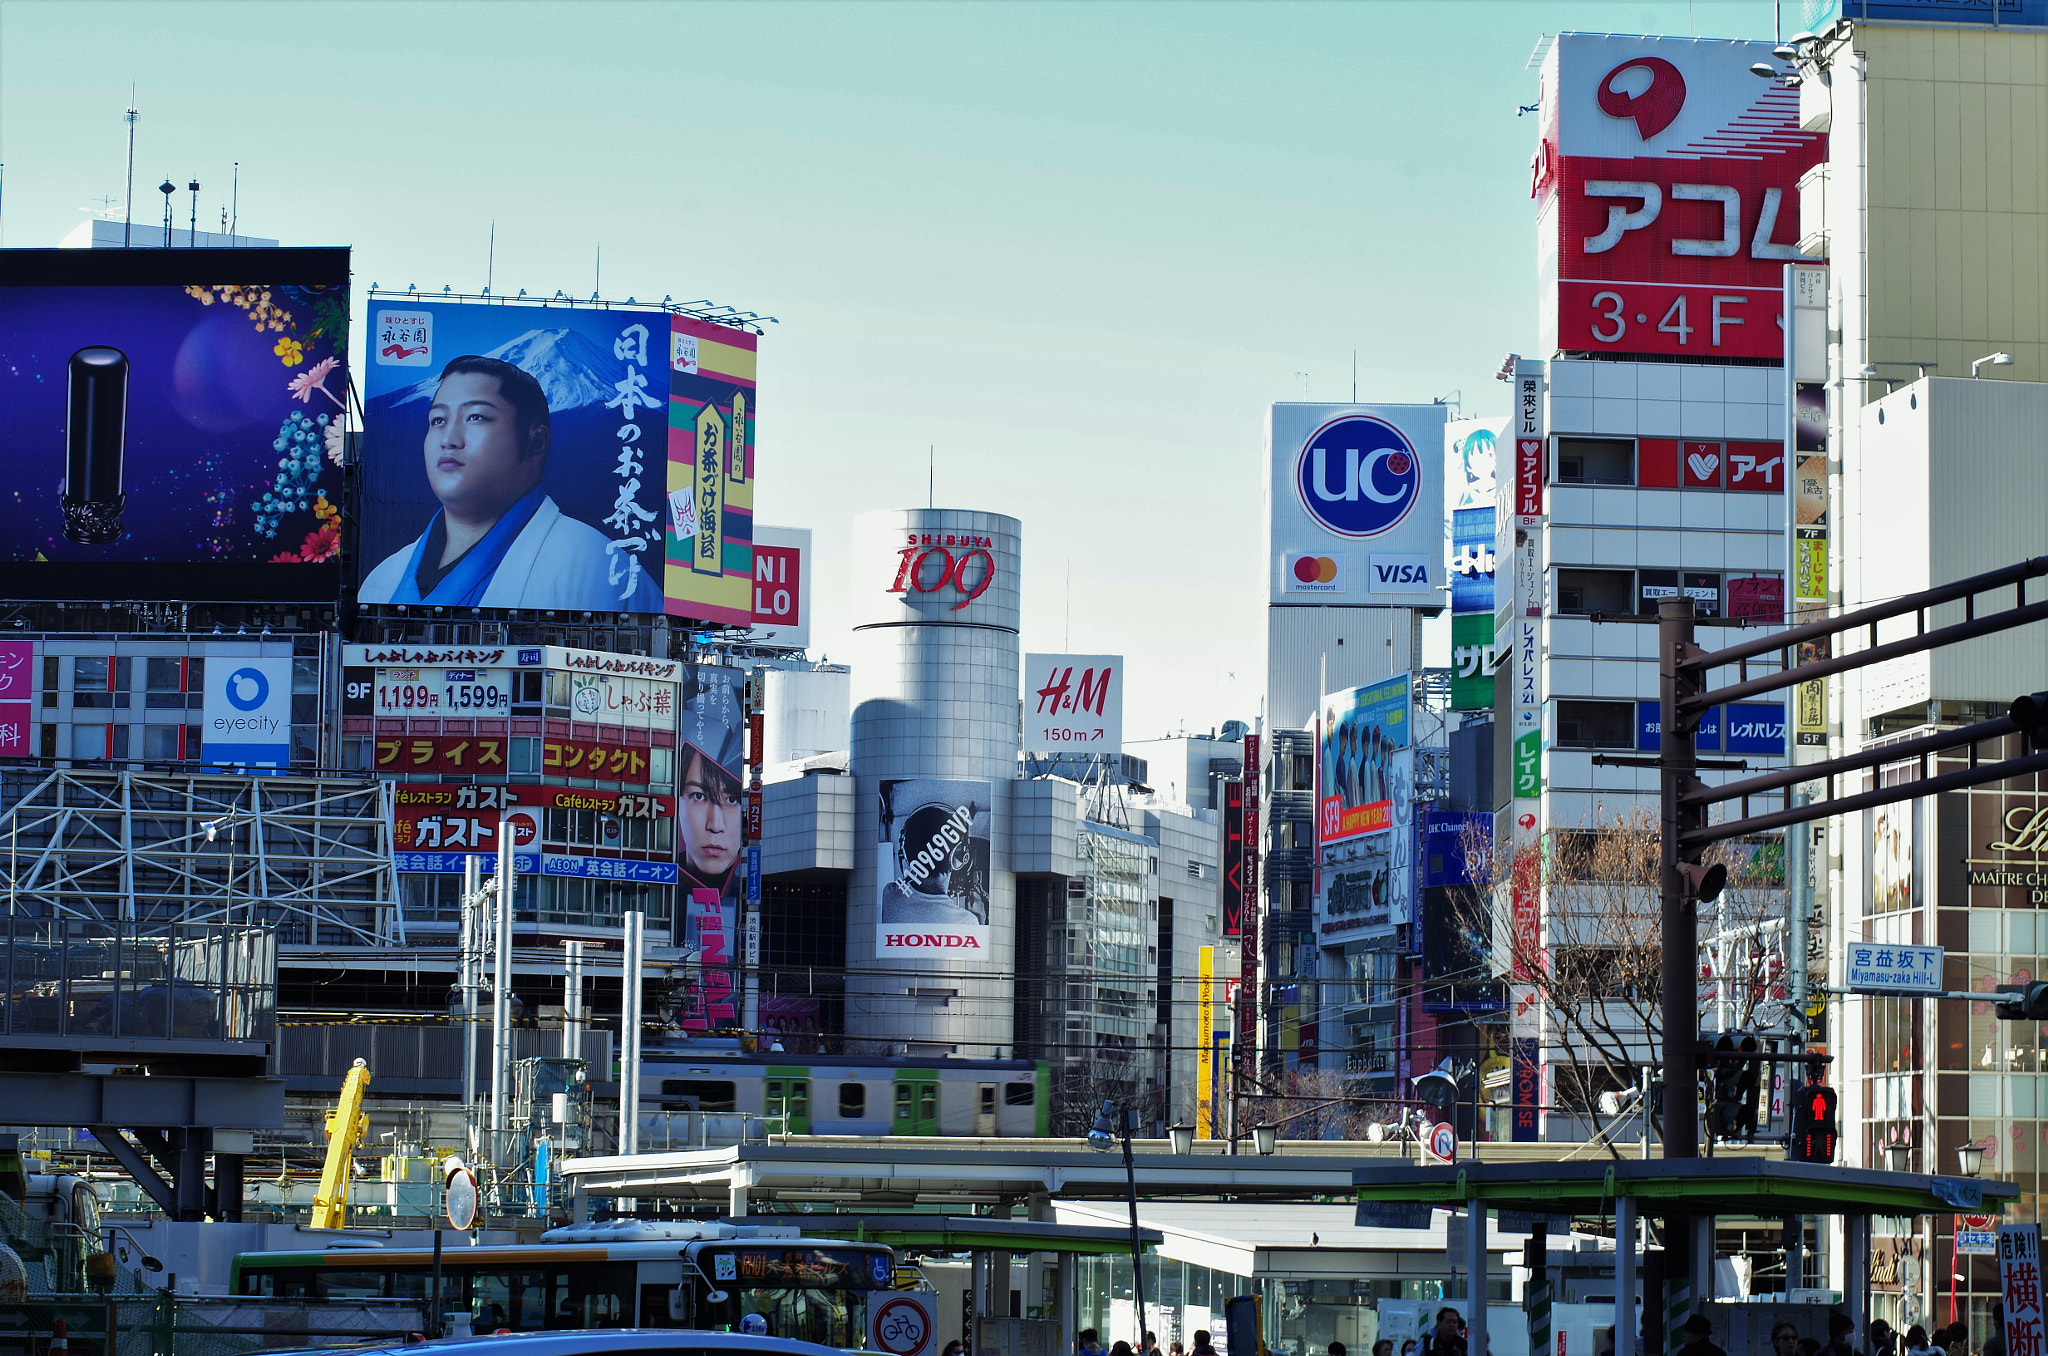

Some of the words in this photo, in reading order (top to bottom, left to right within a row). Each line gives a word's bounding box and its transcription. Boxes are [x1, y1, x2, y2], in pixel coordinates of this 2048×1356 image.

[385, 316, 425, 325] 味ひとすじ
[381, 326, 427, 344] 永谷園
[603, 322, 662, 600] 日本のお茶づけ
[699, 421, 719, 560] お茶づけ海苔
[1522, 457, 1538, 514] アイフル
[908, 534, 993, 549] SHIBUYA
[1803, 529, 1819, 539] 7F
[755, 555, 786, 583] NI
[886, 546, 996, 611] 109
[1373, 564, 1429, 584] VISA
[755, 587, 791, 616] LO
[364, 648, 505, 664] しゃぶしゃぶバイキング
[520, 651, 540, 663] 寿司
[566, 652, 677, 677] しゃぶしゃぶバイキング
[448, 671, 474, 681] ディナー
[709, 672, 718, 705] 真実を
[346, 681, 372, 699] 9F
[607, 684, 672, 716] しゃぶ葉
[1036, 666, 1112, 716] H&M
[214, 714, 280, 734] eyecity
[1803, 733, 1820, 744] 5F
[376, 740, 503, 767] プライス
[543, 743, 646, 775] コンタクト
[1518, 742, 1536, 790] レイク
[456, 784, 518, 809] ガスト
[618, 794, 666, 820] ガスト
[751, 806, 760, 833] ガスト
[1325, 800, 1340, 836] SF9
[1441, 821, 1469, 833] Channel
[415, 815, 493, 848] ガスト
[894, 804, 975, 899] #10969GVP
[549, 860, 579, 871] AEON
[586, 860, 675, 881] 英会話イーオン
[1972, 868, 2023, 886] MAÎTRE
[885, 933, 981, 949] HONDA
[1855, 949, 1936, 970] 宮益坂下
[1851, 968, 1911, 985] Miyamasu-zaka
[1346, 1054, 1386, 1071] Euphoria
[1518, 1060, 1533, 1128] PROMISE
